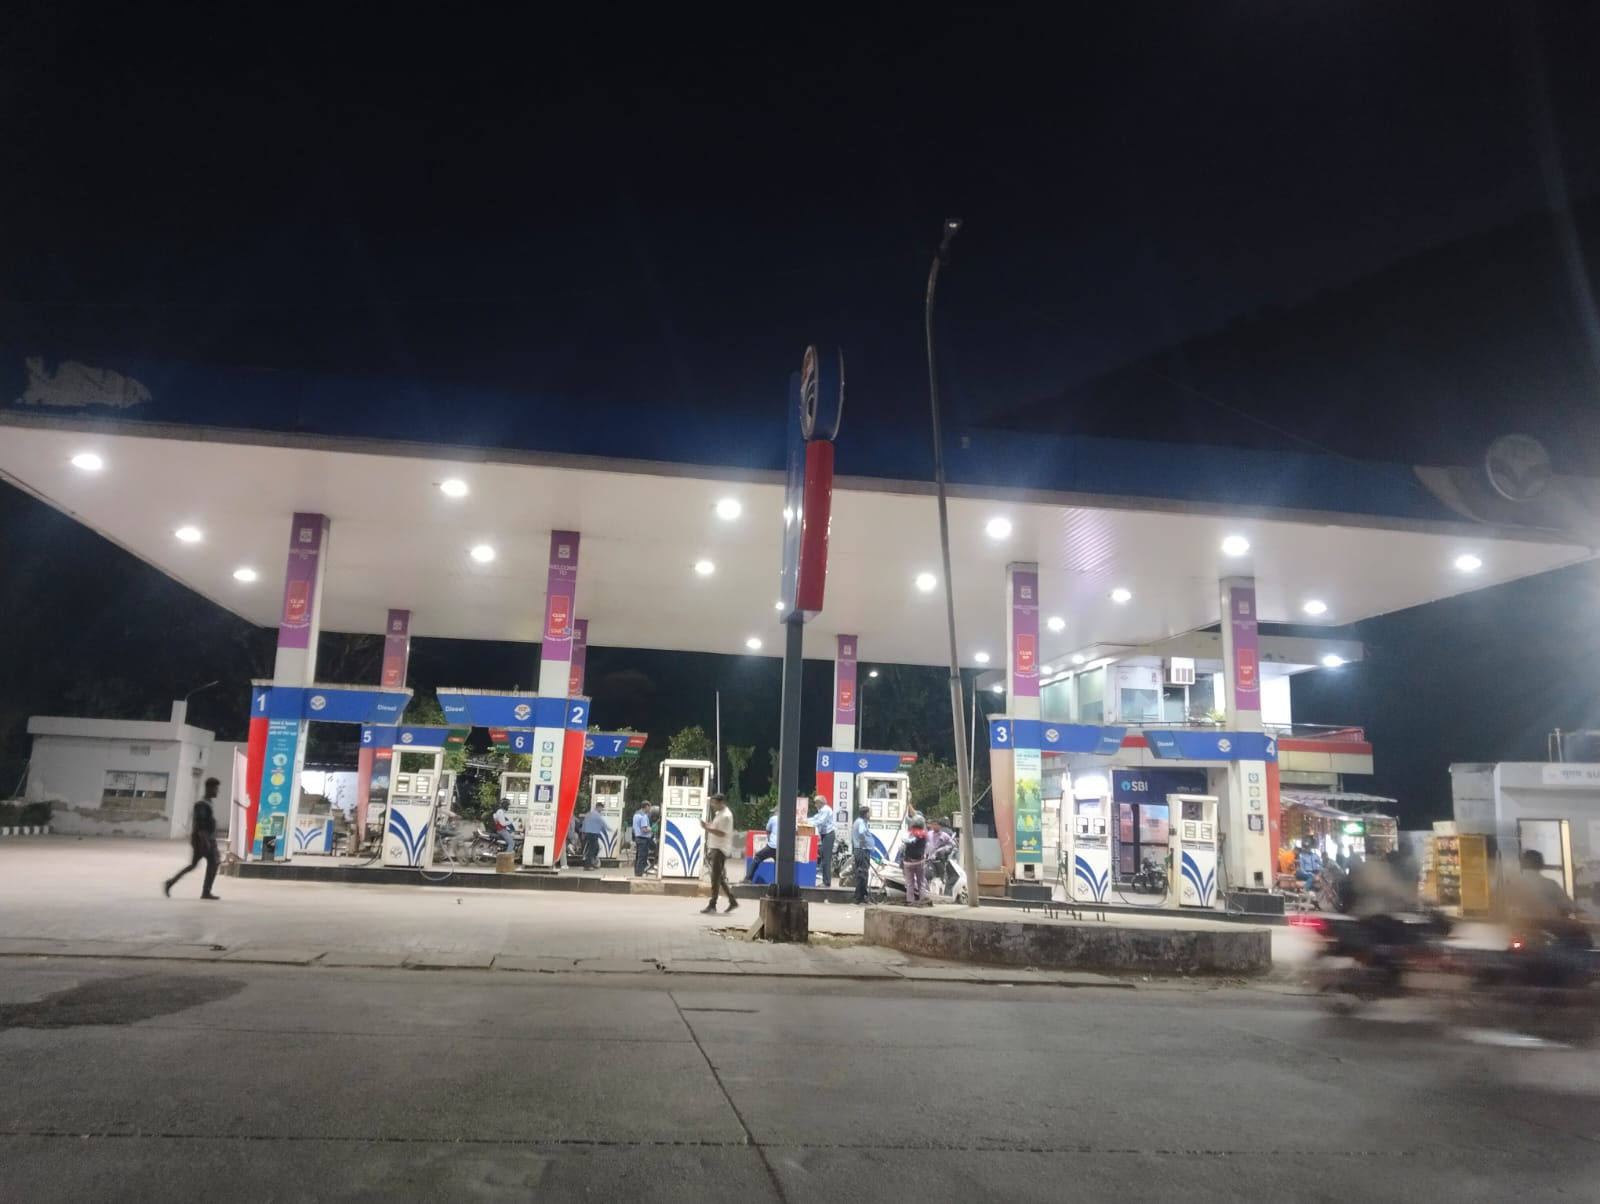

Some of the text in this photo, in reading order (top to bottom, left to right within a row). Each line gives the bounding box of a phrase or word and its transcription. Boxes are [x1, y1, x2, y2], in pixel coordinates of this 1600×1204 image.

[256, 694, 266, 711] 1
[376, 703, 397, 712] Diesel
[445, 705, 465, 713] Diesel
[571, 706, 584, 724] 2
[363, 730, 372, 743] 5
[996, 726, 1008, 742] 3
[515, 735, 525, 749] 6
[613, 739, 622, 752] 7
[1266, 740, 1276, 756] 4
[821, 754, 830, 767] 8
[1131, 780, 1149, 792] SBI
